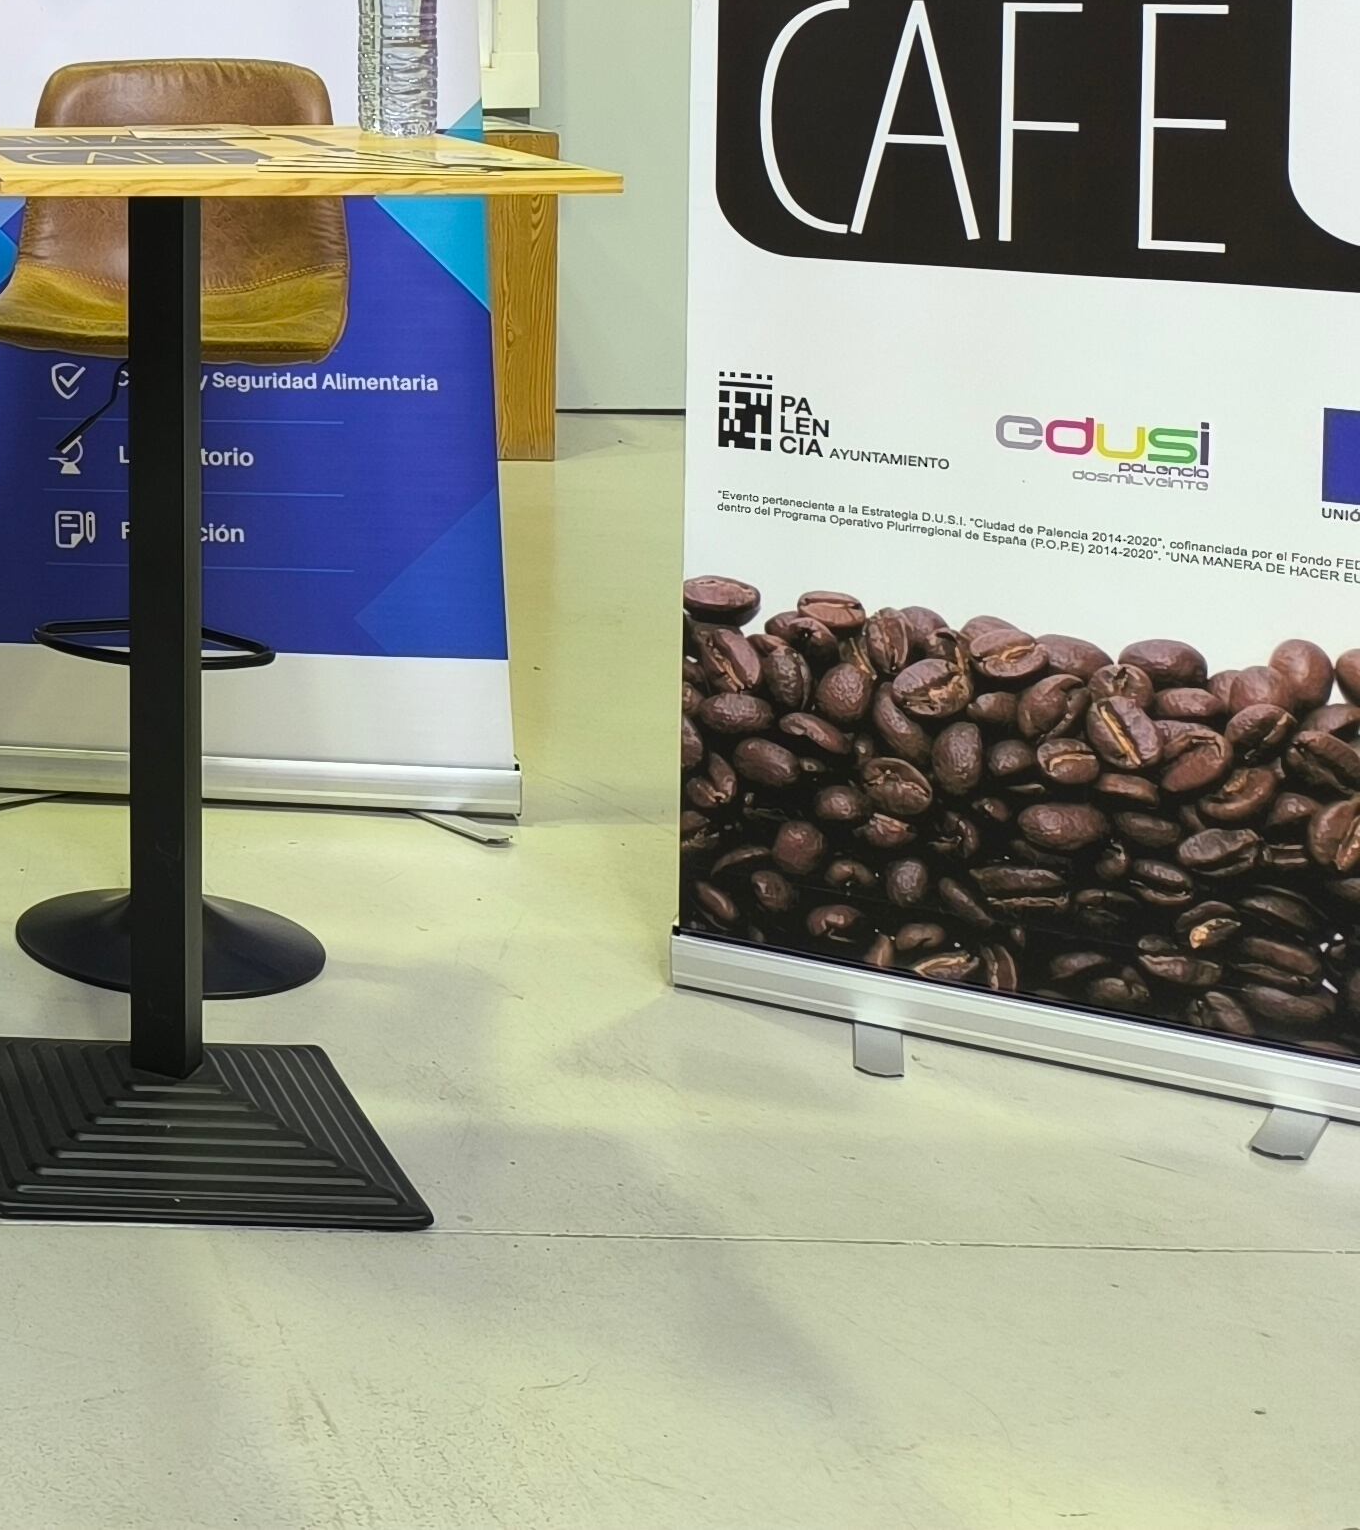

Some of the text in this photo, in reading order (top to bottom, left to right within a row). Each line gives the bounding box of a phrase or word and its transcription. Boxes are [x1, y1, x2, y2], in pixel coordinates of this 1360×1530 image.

[212, 372, 317, 393] Seguridad
[322, 373, 438, 392] Alimentaria
[780, 395, 812, 415] PA
[780, 415, 829, 437] LEN
[780, 436, 823, 457] CIA
[996, 415, 1209, 465] edusi
[829, 448, 949, 469] AYUNTAMIENTO
[717, 503, 751, 514] dentro
[755, 506, 770, 516] del
[774, 508, 826, 523] Programa
[830, 515, 883, 529] Operativo
[965, 531, 979, 540] de
[983, 532, 1026, 546] España
[1202, 555, 1262, 572] MANERA
[1266, 562, 1285, 574] DE
[1290, 564, 1339, 581] HACER
[762, 496, 834, 512] perteneciente
[849, 504, 858, 514] la
[862, 506, 918, 521] Estrategia
[1019, 524, 1033, 534] de
[1037, 526, 1088, 541] Palencia
[1170, 540, 1247, 557] cofinanciada
[1252, 549, 1272, 560] por
[1276, 551, 1287, 560] el
[1292, 553, 1331, 567] Fondo
